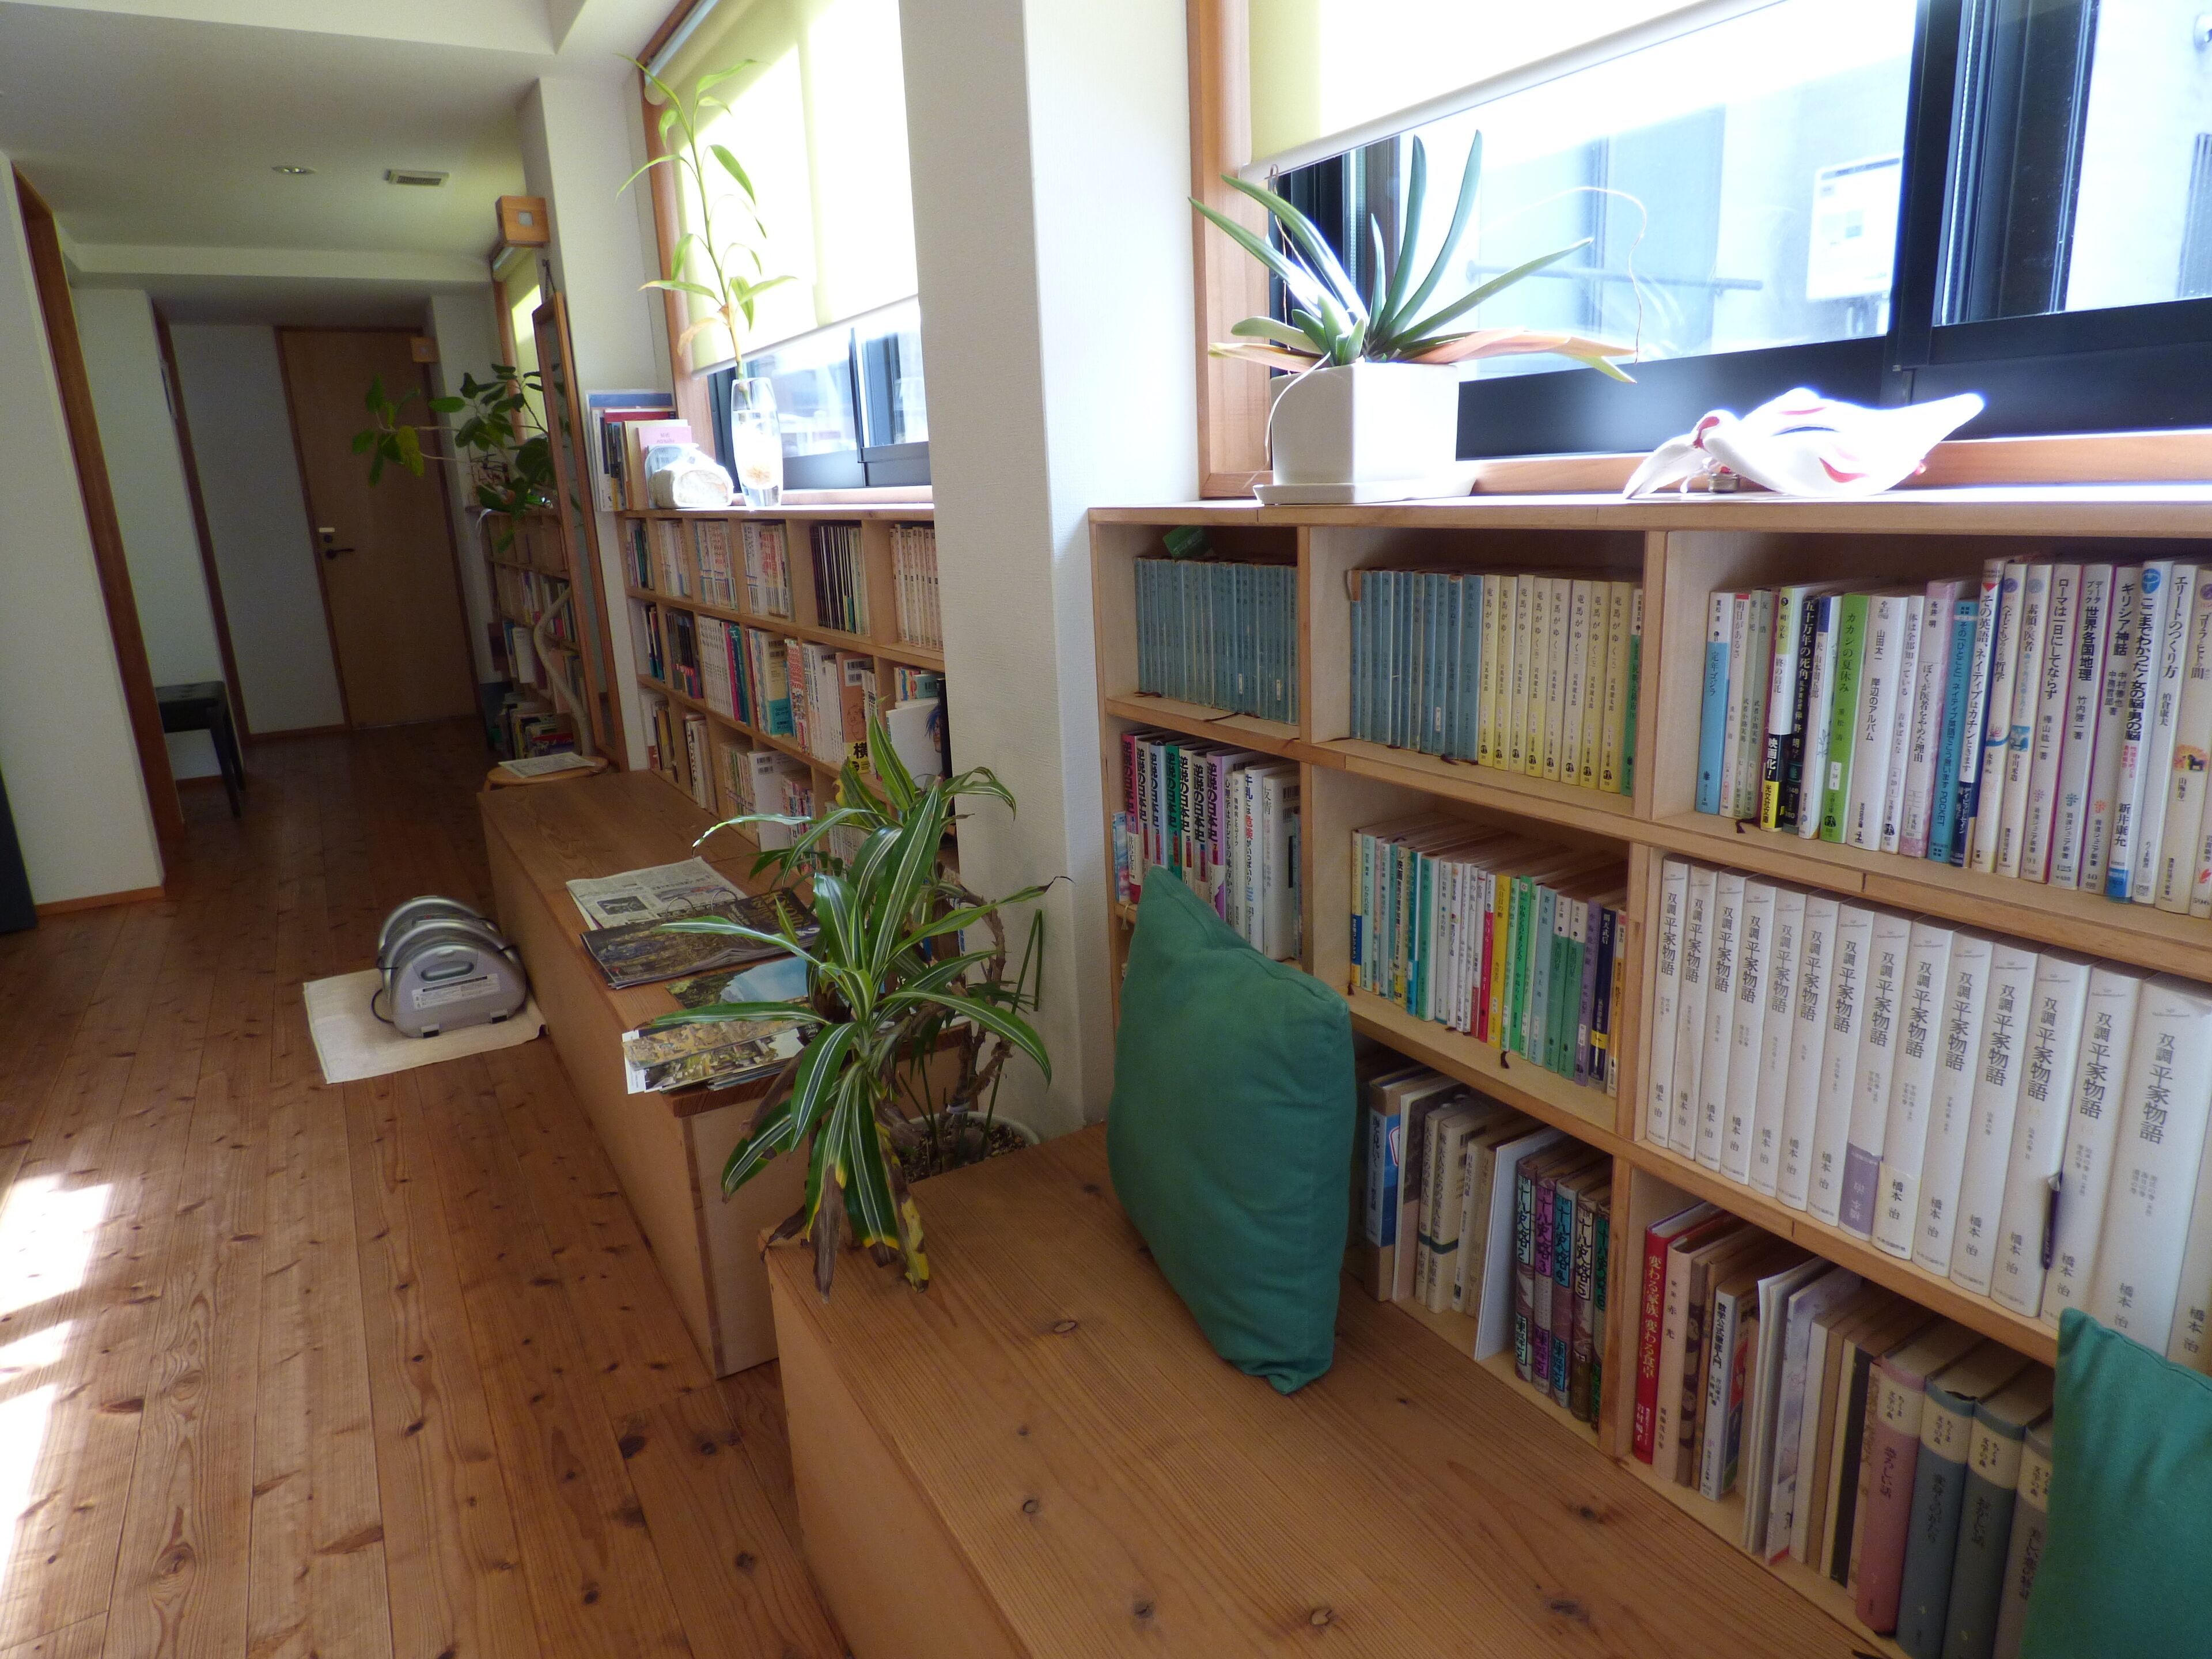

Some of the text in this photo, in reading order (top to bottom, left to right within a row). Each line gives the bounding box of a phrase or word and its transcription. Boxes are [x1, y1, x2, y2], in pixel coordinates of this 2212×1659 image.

[1485, 588, 1493, 641] 竜馬がゆく
[1519, 588, 1527, 643] 竜馬がゆく
[1535, 592, 1543, 647] 竜馬がゆく
[1553, 593, 1562, 649] 竜馬がゆく
[2085, 581, 2094, 603] ブック
[2093, 581, 2103, 603] データ
[2113, 583, 2134, 656] ギリシア神話
[1574, 594, 1584, 652] 竜馬がゆく
[1592, 596, 1601, 655] 竜馬がゆく
[1612, 597, 1622, 655] 竜馬がゆく
[1734, 601, 1745, 658] 明日があるさ
[1799, 601, 1815, 680] 五十万年の死角
[1874, 629, 1885, 660] 山田太一
[2024, 604, 2039, 652] 素顔の医者
[2044, 579, 2069, 700] ローマは一日にしてならず
[2078, 607, 2099, 681] 世界各国地理
[2162, 576, 2188, 679] エリートのつくり方
[1709, 651, 1719, 696] 定年ゴジラ
[1774, 658, 1784, 694] 終の信託
[1839, 613, 1856, 692] カカシの夏休み
[1865, 677, 1880, 741] 岸辺のアルバム
[1895, 613, 1918, 753] 体は全部知っている 吉本ばなな
[1914, 601, 1938, 763] 永井明 ぼくが医者をやめた理由
[1961, 595, 1994, 773] その英語、ネイティブはカチンときます
[1123, 741, 1135, 813] 逆説の日本史
[1137, 748, 1148, 821] 逆説の日本史
[1766, 737, 1779, 779] 映画化！
[2010, 753, 2020, 782] 中川米造
[1150, 752, 1160, 827] 逆説の日本史
[1166, 751, 1177, 828] 逆説の日本史
[1180, 755, 1191, 833] 逆説の日本史
[1194, 763, 1205, 843] 逆説の日本史
[1207, 762, 1218, 843] 逆説の日本史
[1762, 785, 1772, 824] 光文社文庫
[1937, 791, 1949, 827] POCKET
[1245, 773, 1253, 886] 牛乳には危険がいっぱい？
[2029, 807, 2040, 853] 岩波ジュニア新書
[2061, 812, 2073, 859] 岩波ジュニア新書
[2089, 819, 2102, 866] 岩波ジュニア新書
[2114, 802, 2131, 848] 新井康允
[1397, 860, 1404, 881] 映画
[2056, 864, 2072, 873] 125
[1541, 896, 1550, 925] 蒼き狼
[1661, 892, 1677, 976] 双調平家物語
[1685, 899, 1703, 983] 双調平家物語
[1714, 906, 1733, 993] 双調平家物語
[1741, 915, 1760, 1004] 双調平家物語
[1771, 925, 1791, 1014] 双調平家物語
[1800, 930, 1822, 1021] 双調平家物語
[1834, 940, 1857, 1034] 双調平家物語
[1870, 952, 1895, 1047] 双調平家物語
[1905, 961, 1932, 1059] 双調平家物語
[1945, 972, 1973, 1071] 双調平家物語
[1985, 984, 2016, 1087] 双調平家物語
[2027, 997, 2058, 1103] 双調平家物語
[2080, 1012, 2112, 1120] 双調平家物語
[1654, 1082, 1664, 1118] 橋本治
[1678, 1090, 1688, 1127] 橋本治
[2139, 1032, 2176, 1145] 双調平家物語
[1704, 1103, 1715, 1139] 橋本治
[1730, 1114, 1742, 1152] 橋本治
[1759, 1127, 1772, 1164] 橋本治
[1422, 1125, 1434, 1209] 大人のための偉人伝
[1786, 1137, 1800, 1176] 橋本治
[1819, 1151, 1832, 1190] 橋本治
[1888, 1179, 1903, 1221] 橋本治
[1927, 1196, 1943, 1238] 橋本治
[1965, 1214, 1982, 1257] 橋本治
[2006, 1232, 2023, 1275] 橋本治
[2057, 1252, 2075, 1297] 橋本治
[1642, 1255, 1662, 1378] 変わる家族 変わる食卓
[2114, 1282, 2134, 1329] 橋本治
[2183, 1306, 2206, 1354] 橋本治
